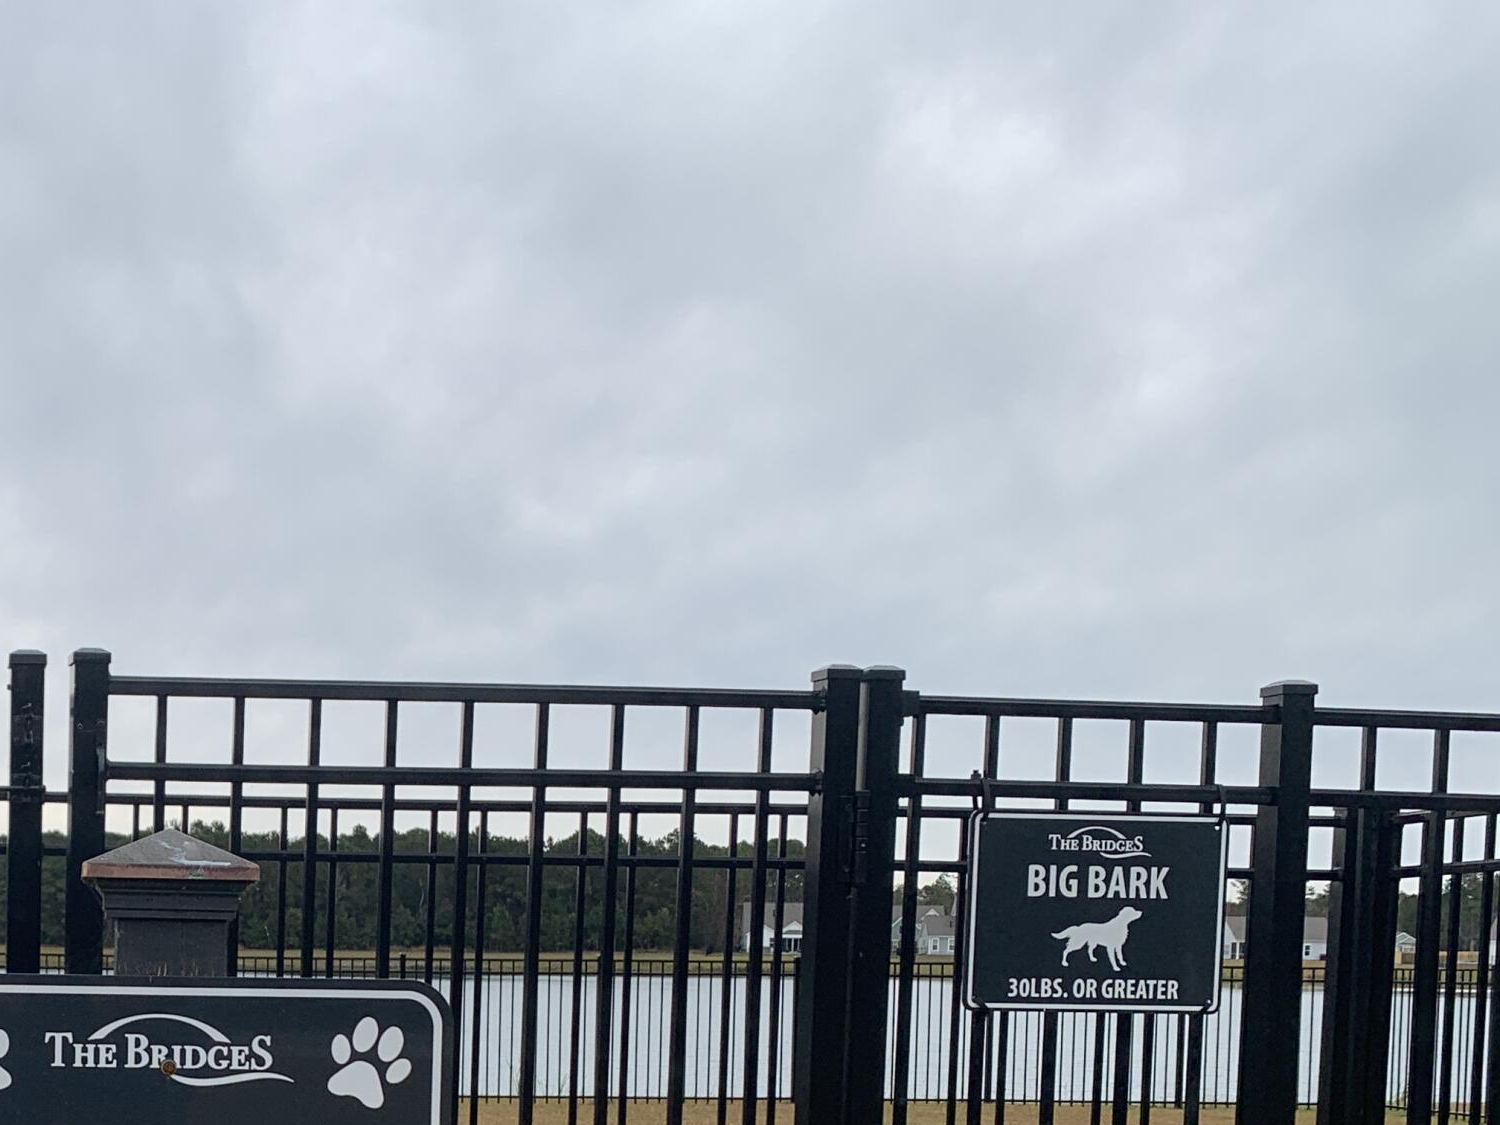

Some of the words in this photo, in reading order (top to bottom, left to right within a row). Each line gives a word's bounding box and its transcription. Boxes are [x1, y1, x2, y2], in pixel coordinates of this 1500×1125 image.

[1027, 864, 1079, 898] BIG
[1087, 865, 1170, 900] BARK
[1007, 977, 1068, 998] 30LBS.
[1072, 978, 1098, 999] OR
[1101, 978, 1179, 1000] GREATER
